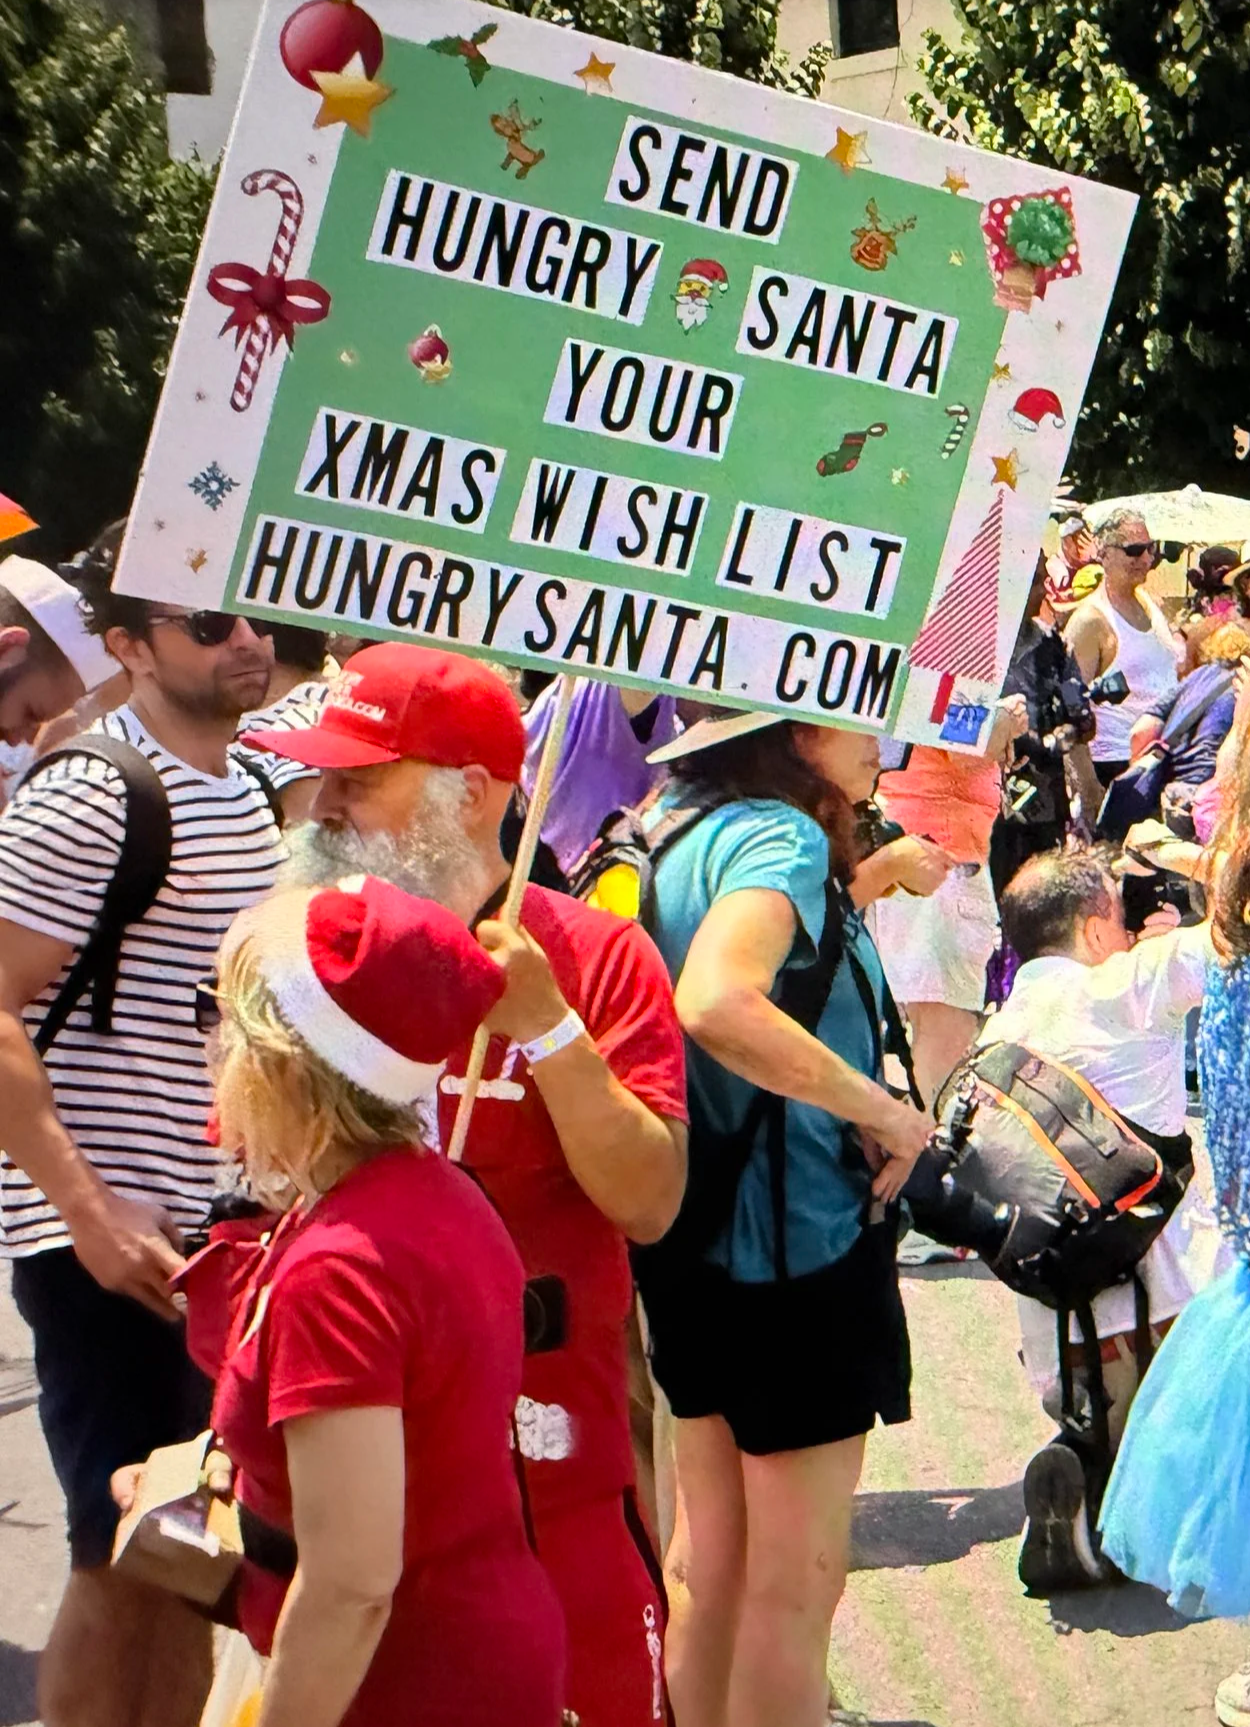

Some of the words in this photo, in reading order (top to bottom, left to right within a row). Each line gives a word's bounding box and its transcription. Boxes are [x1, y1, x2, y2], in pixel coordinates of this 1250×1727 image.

[618, 125, 790, 236] SEND
[381, 175, 661, 318] HUNGRY
[747, 276, 945, 395] SANTA
[565, 343, 735, 453] YOUR
[304, 413, 496, 525] XMAS
[530, 464, 705, 570] WISH
[725, 508, 902, 612] LIST
